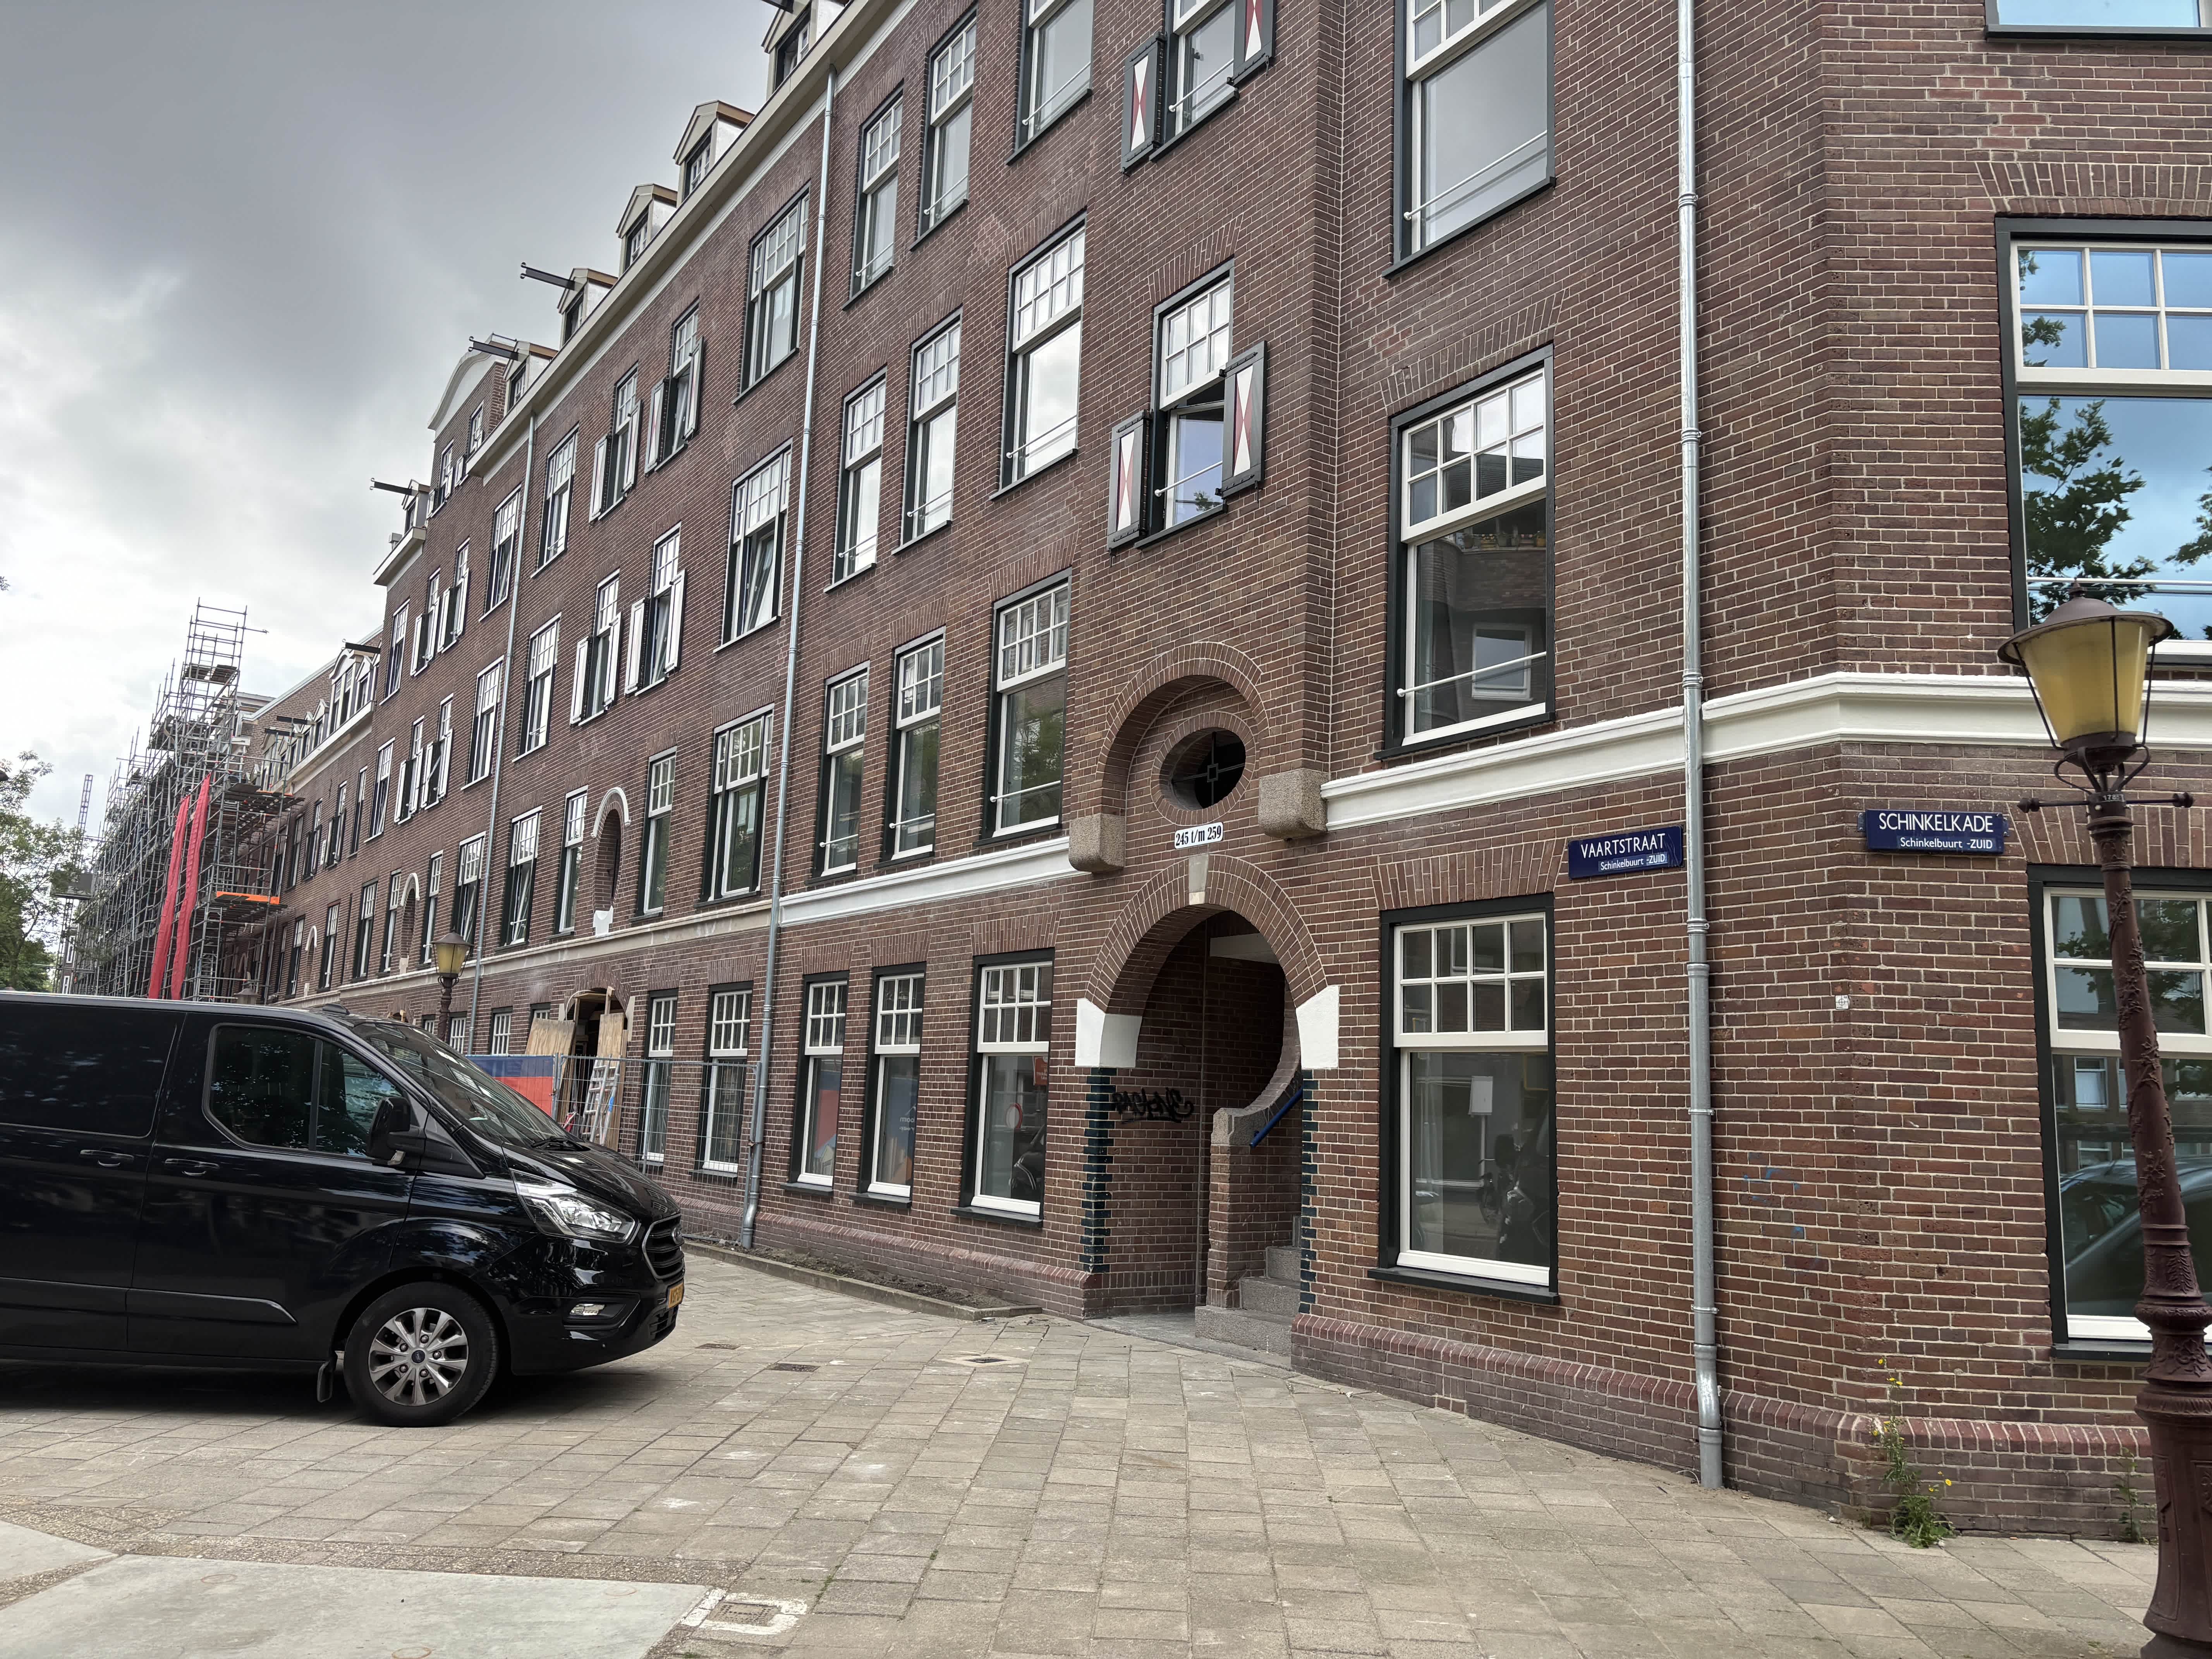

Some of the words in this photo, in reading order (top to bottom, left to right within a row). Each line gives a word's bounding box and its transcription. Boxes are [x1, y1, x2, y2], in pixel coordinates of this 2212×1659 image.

[1879, 813, 1994, 832] SCHINKELKADE
[1176, 832, 1188, 846] 245
[1191, 829, 1205, 843] t/m
[1207, 825, 1221, 840] 259
[1900, 837, 1963, 848] Schinkelbuurt
[1580, 833, 1665, 859] VAARTSTRAAT
[1601, 858, 1644, 871] Schinkelbuurt
